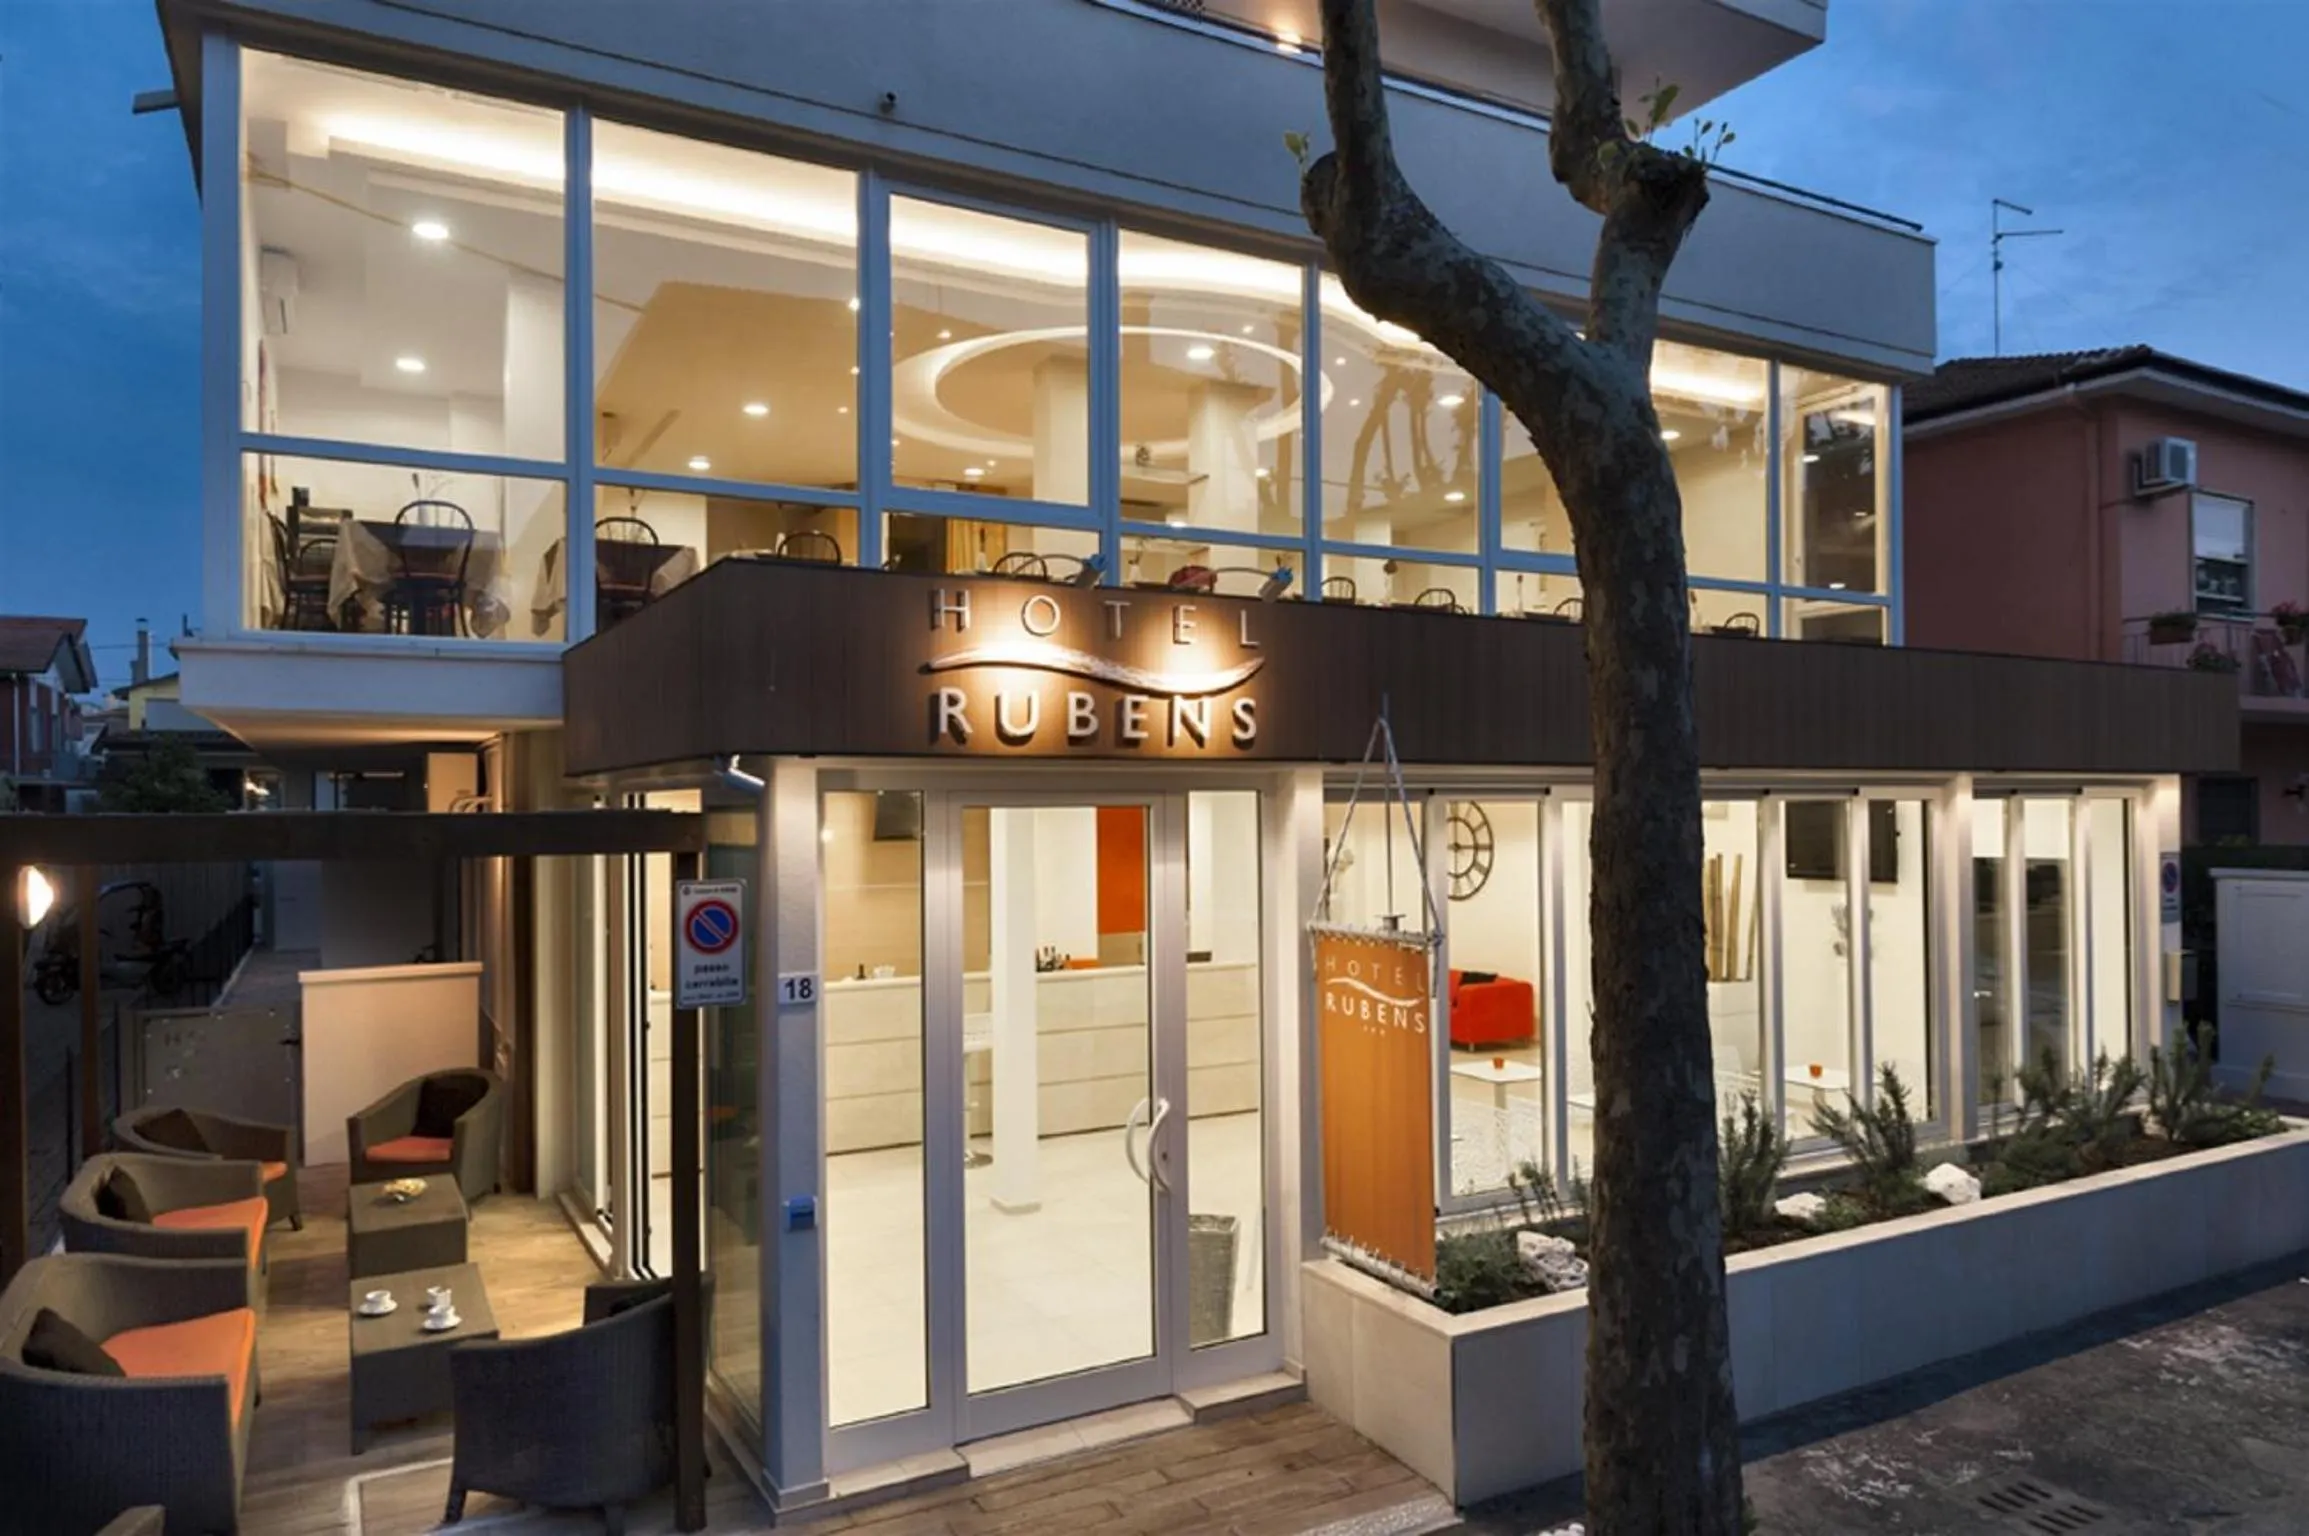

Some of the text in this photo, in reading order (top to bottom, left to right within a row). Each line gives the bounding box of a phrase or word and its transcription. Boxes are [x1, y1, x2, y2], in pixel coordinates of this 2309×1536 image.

[932, 588, 1260, 647] HOTEL
[934, 687, 1258, 744] RUBENS
[785, 977, 813, 1000] 18
[1325, 955, 1425, 993] HOTEL
[1325, 991, 1426, 1034] RUBENS
